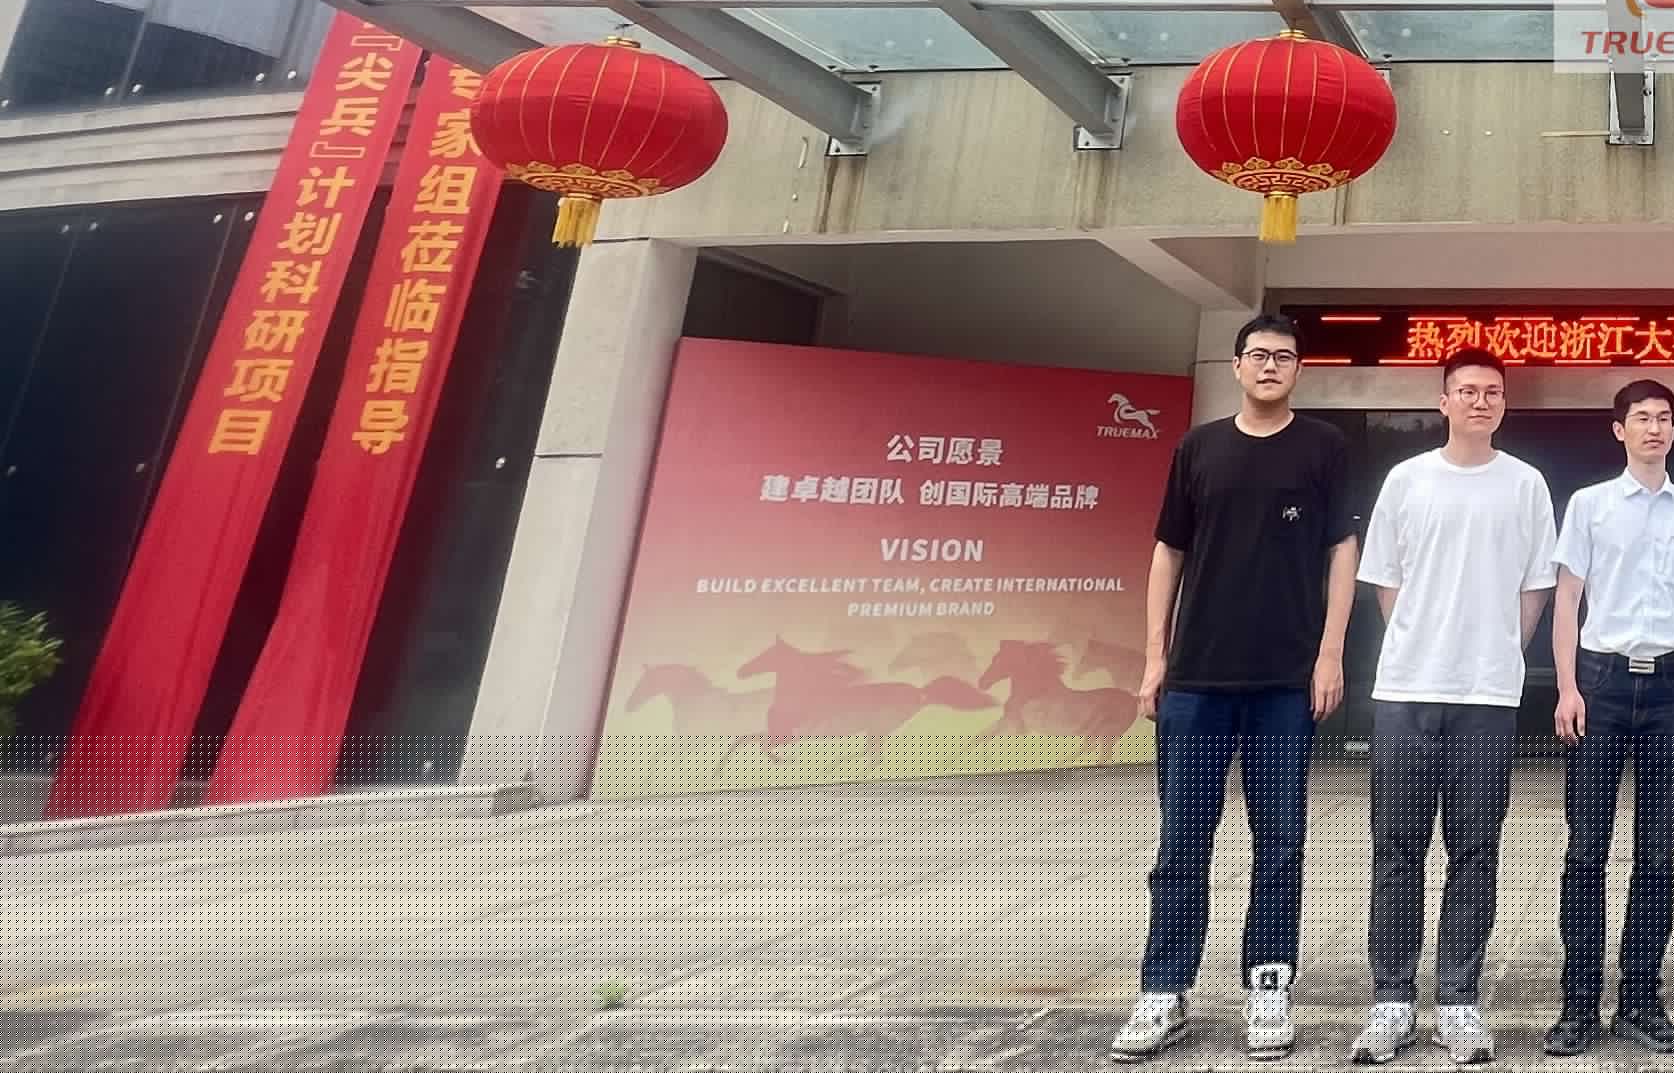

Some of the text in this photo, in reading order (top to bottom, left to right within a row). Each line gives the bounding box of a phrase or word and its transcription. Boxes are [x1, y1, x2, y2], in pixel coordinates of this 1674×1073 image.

[1097, 425, 1159, 439] TRUEMAX
[887, 434, 1003, 466] 公司愿景
[760, 475, 1099, 510] 建卓越团队 创国际高端品牌
[879, 538, 985, 562] VISION
[696, 577, 758, 594] BUILD
[762, 577, 867, 594] EXCELLENT
[871, 577, 926, 596] TEAM,
[997, 577, 1126, 593] INTERNATIONAL
[847, 601, 995, 617] PREMIUM BRAND
